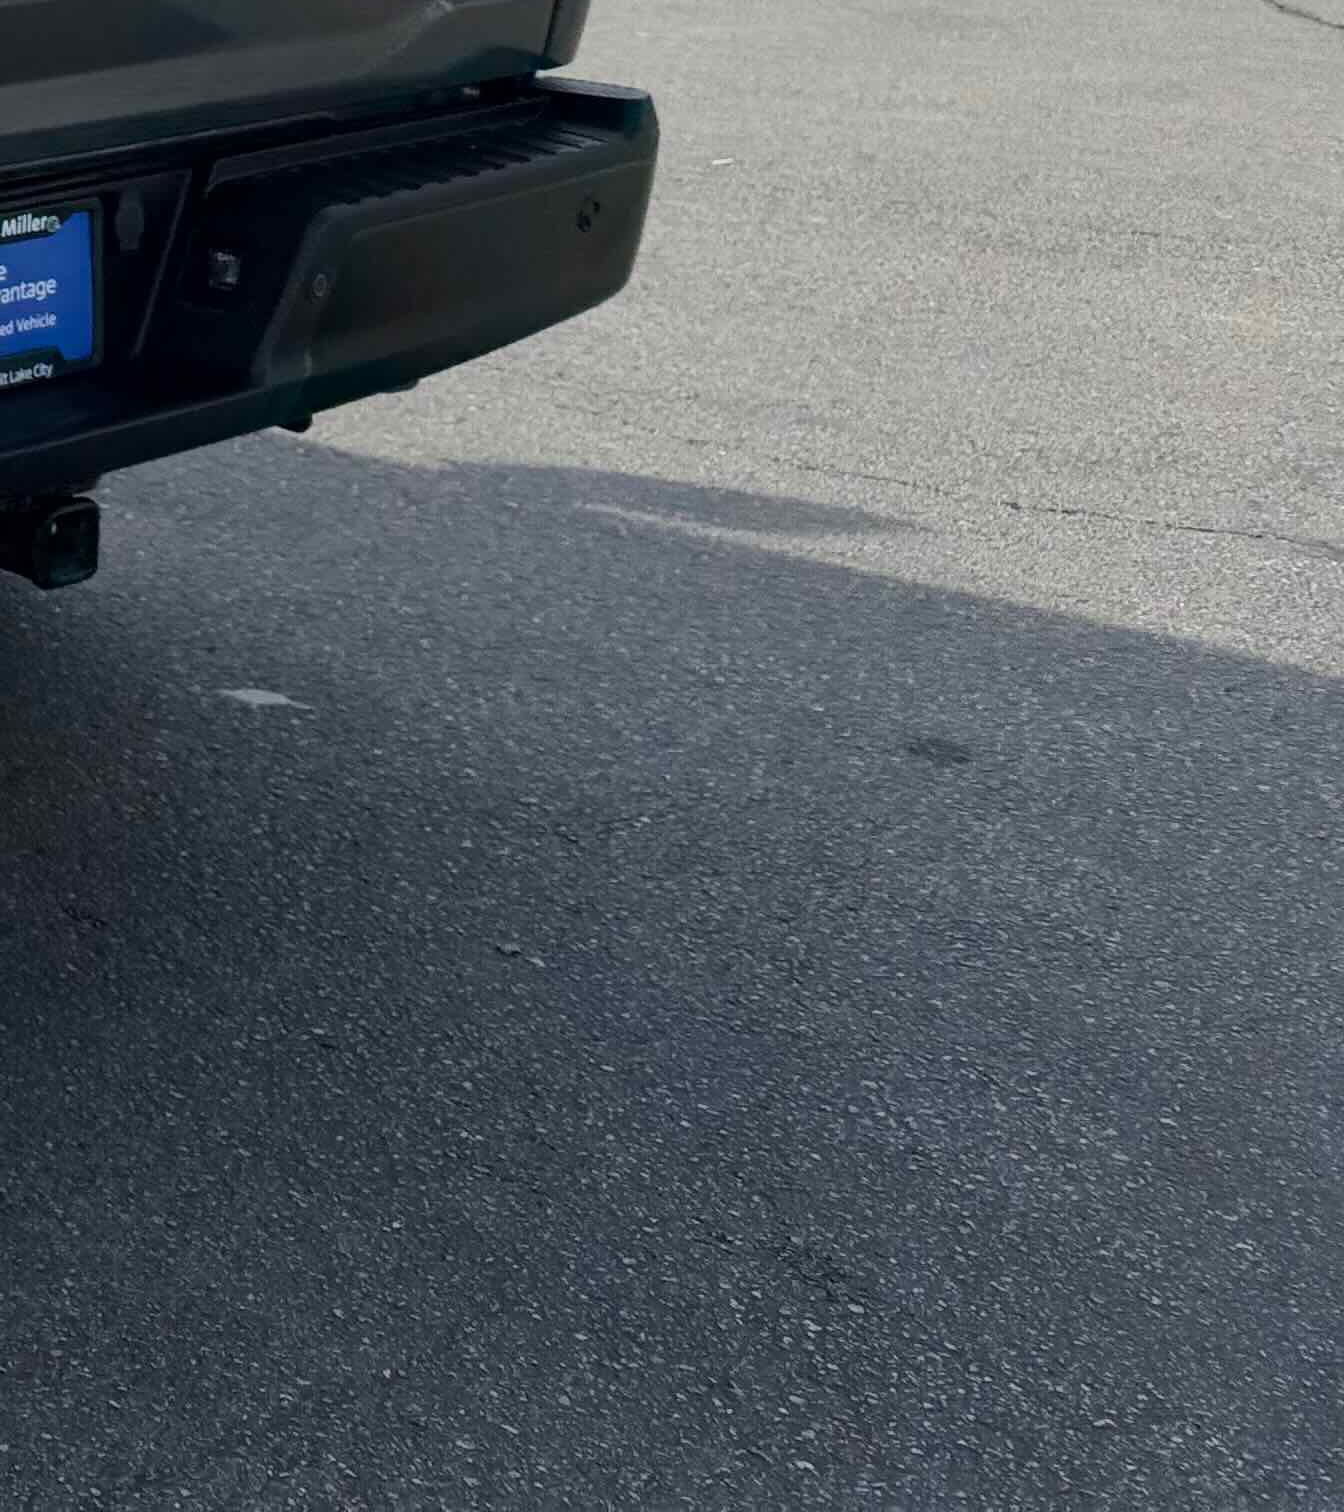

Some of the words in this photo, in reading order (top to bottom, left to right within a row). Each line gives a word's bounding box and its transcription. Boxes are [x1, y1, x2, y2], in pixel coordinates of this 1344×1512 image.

[1, 212, 49, 237] Miller
[16, 312, 57, 333] Vehicle
[9, 368, 33, 384] Lake
[33, 362, 54, 380] City
